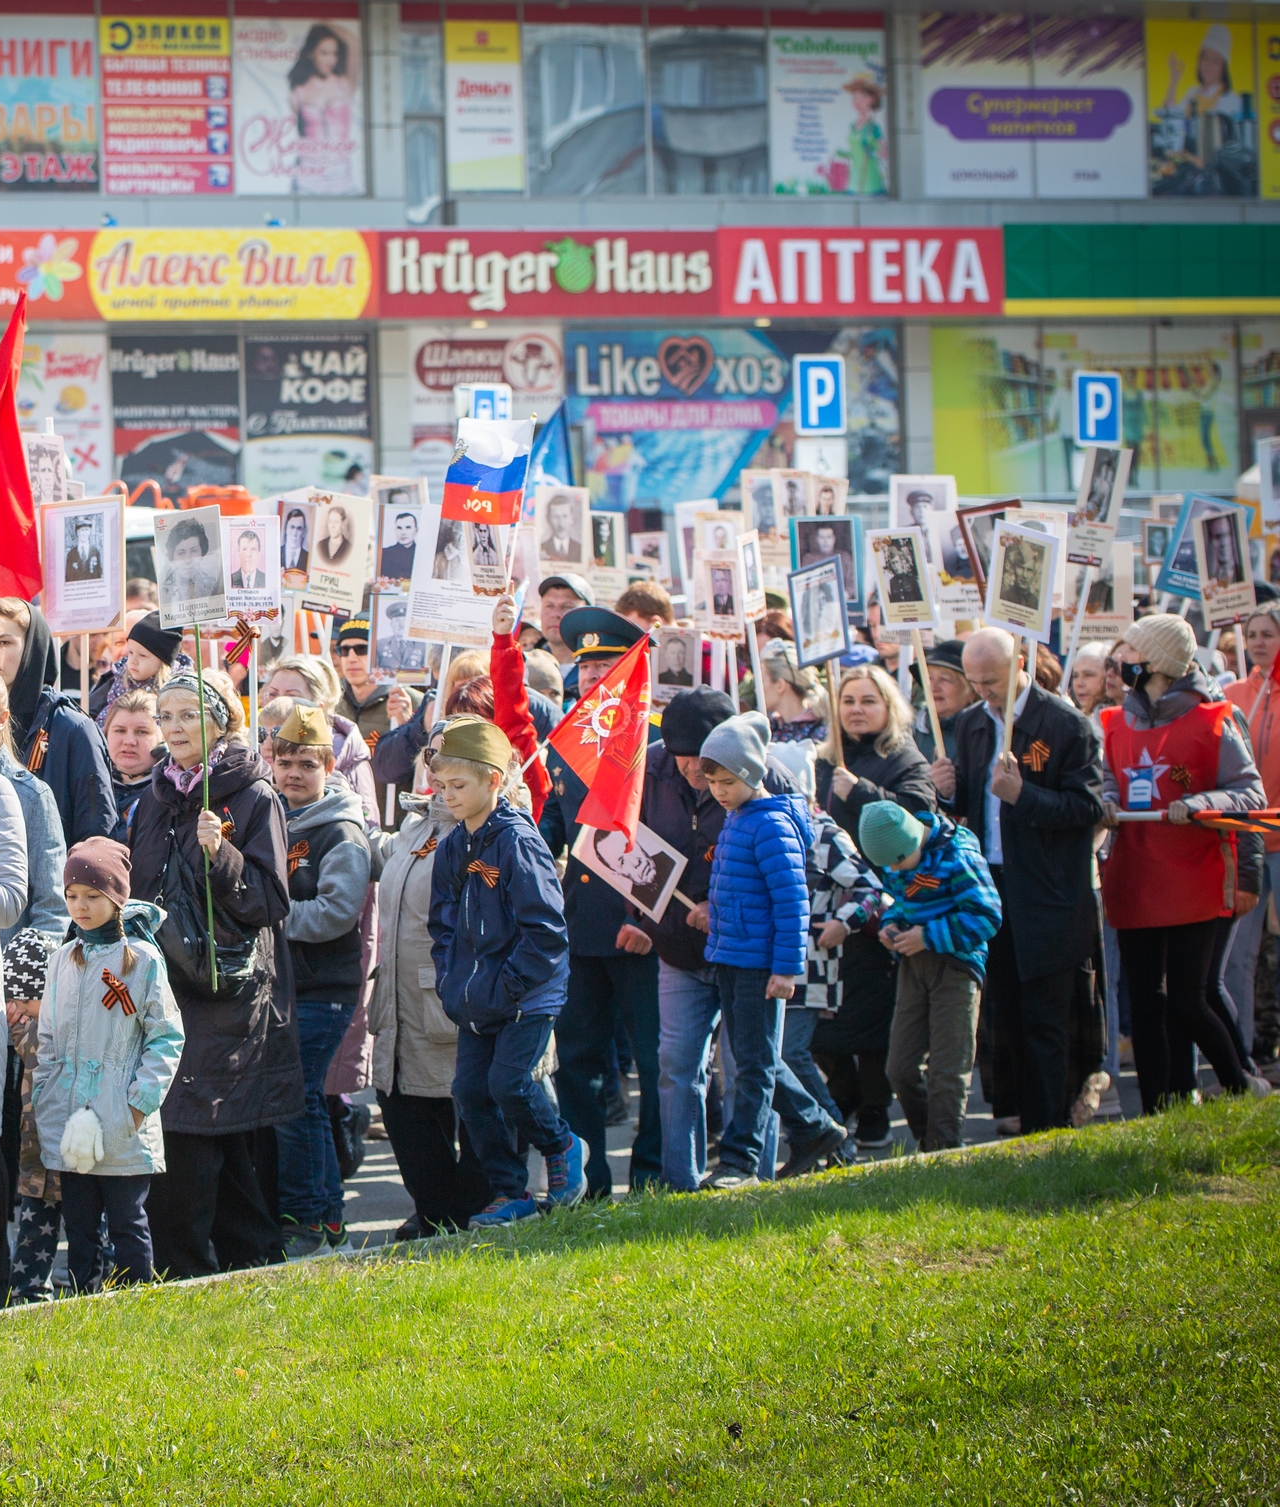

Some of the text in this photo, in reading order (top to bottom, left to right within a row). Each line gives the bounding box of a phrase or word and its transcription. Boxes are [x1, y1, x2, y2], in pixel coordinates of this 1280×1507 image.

[136, 24, 222, 41] ЭЛИКОН
[237, 28, 287, 44] МОДНО
[237, 46, 297, 62] СТИЛЬНО
[104, 57, 230, 74] БЫТОВАЯ ТЕХНИКА
[106, 79, 203, 97] ТЕЛЕФОНИЯ
[457, 78, 512, 99] Деньги
[965, 93, 1096, 118] Супермаркет
[987, 119, 1077, 137] напитков
[107, 137, 207, 154] РАДИОТОВАРЫ
[0, 153, 98, 183] ЭТАЖ
[96, 239, 358, 294] Алекс Вилл
[386, 237, 713, 312] Krüger Haus
[733, 239, 991, 305] АПТЕКА
[111, 295, 157, 311] ценой
[162, 297, 232, 312] приятно
[301, 346, 368, 375] ЧАЙ
[422, 342, 504, 369] Шапки
[575, 344, 663, 396] Like
[280, 377, 367, 404] КОФЕ
[807, 366, 836, 427] P
[599, 406, 764, 429] ТОВАРЫ ДЛЯ ДОМА
[1086, 381, 1113, 438] P
[320, 574, 340, 588] ГРИЦ
[164, 606, 225, 622] Мария Фёдоровна
[178, 601, 209, 612] Панина
[1070, 624, 1118, 634] РЕПЕЛКО
